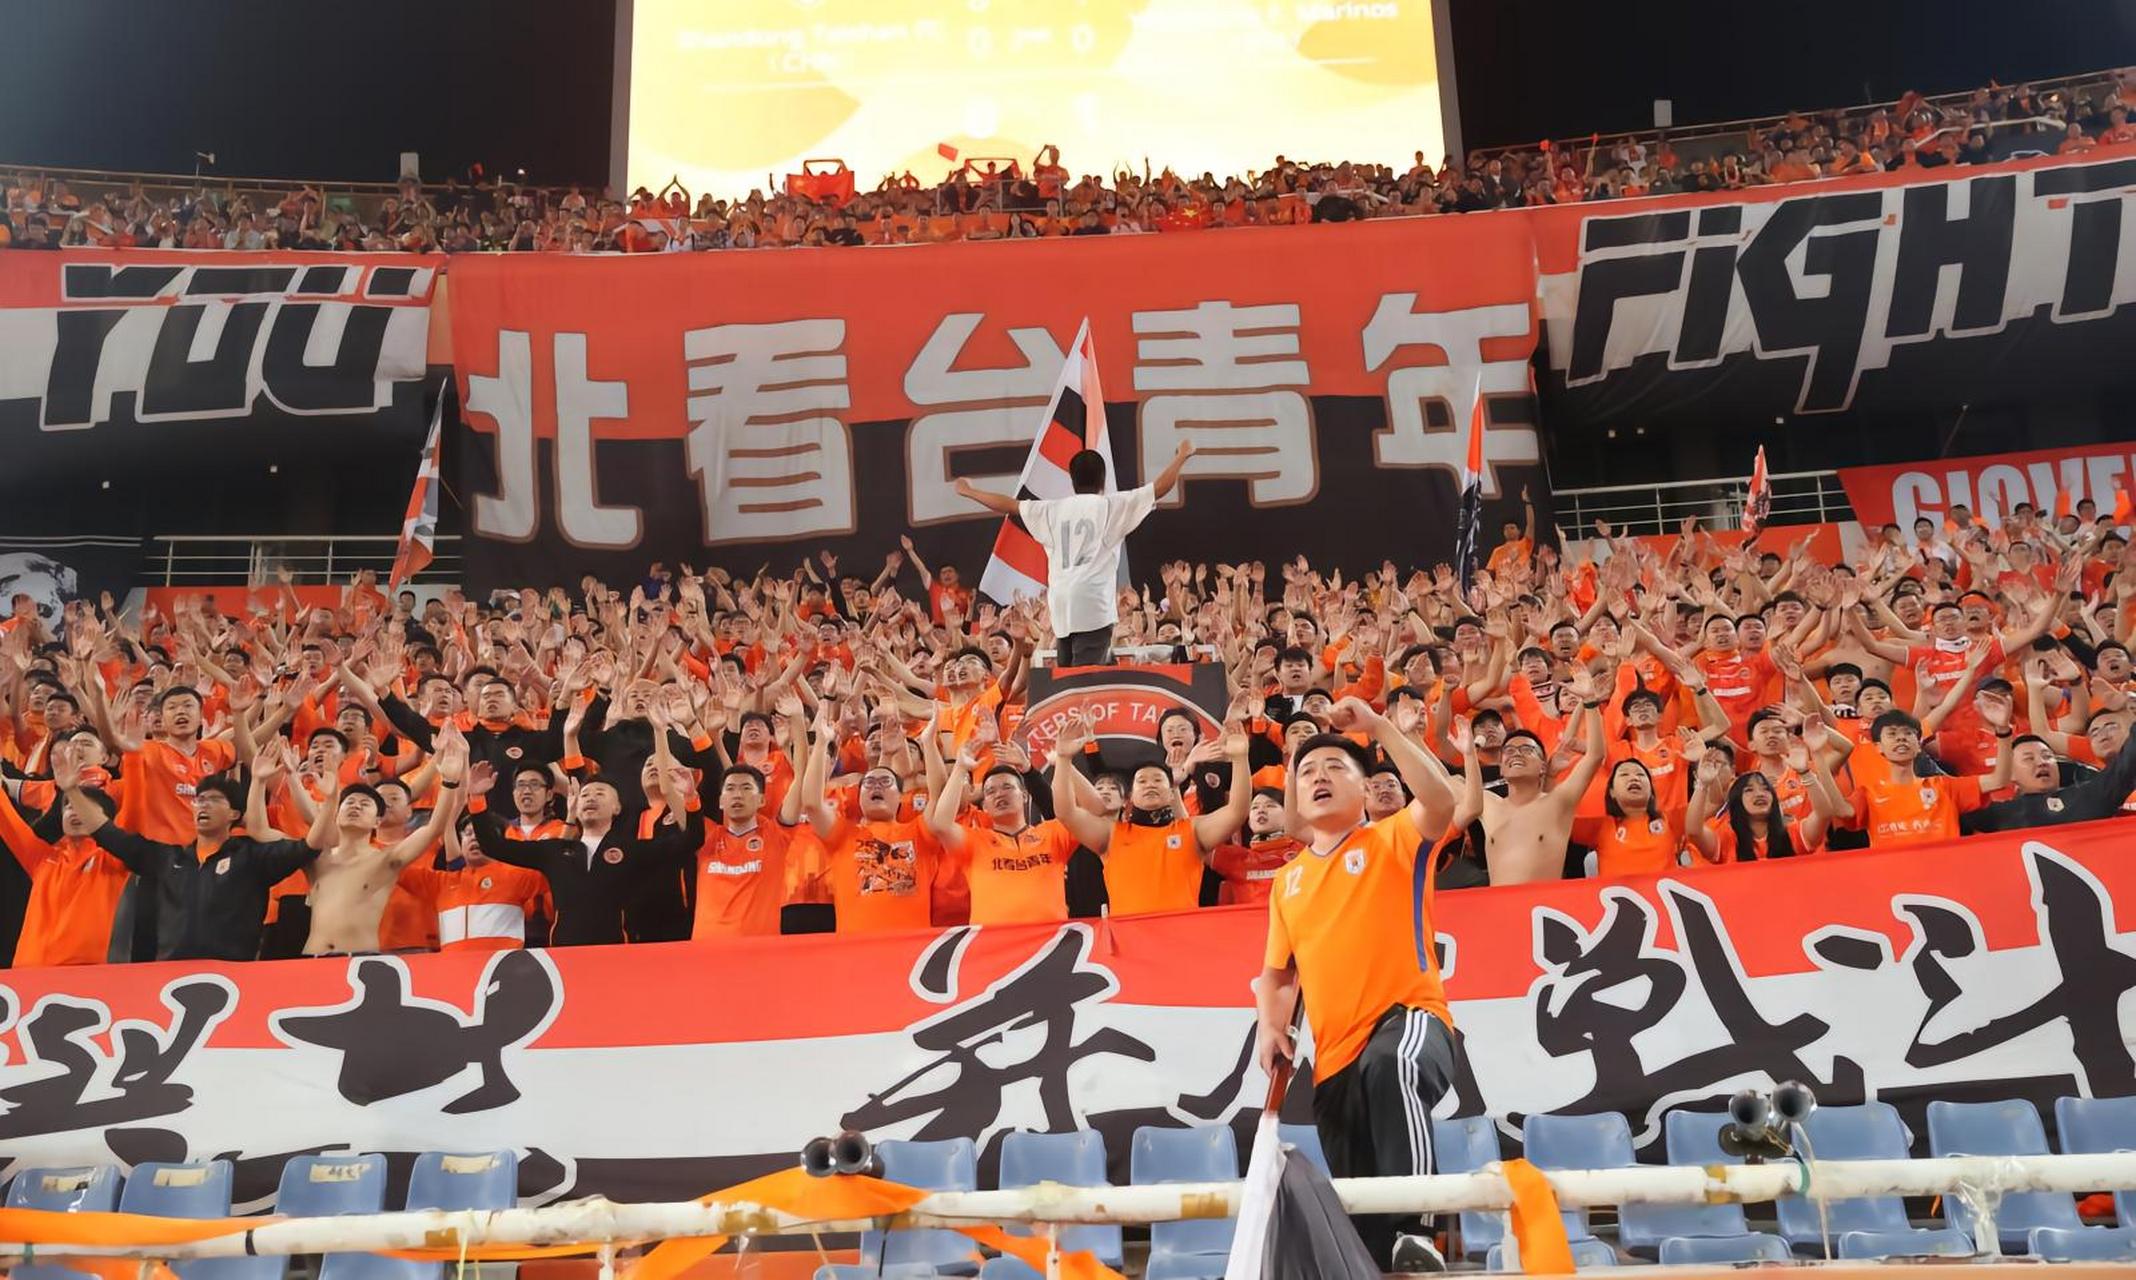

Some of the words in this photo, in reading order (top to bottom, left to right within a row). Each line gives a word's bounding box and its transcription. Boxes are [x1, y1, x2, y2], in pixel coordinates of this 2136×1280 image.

[1567, 157, 2136, 413] FIGHT
[466, 291, 1538, 546] 北看台青年
[1892, 455, 2136, 546] GIOVE
[1061, 518, 1095, 570] 12
[1091, 702, 1120, 721] OF
[1131, 702, 1164, 722] TA
[1284, 865, 1304, 898] 12
